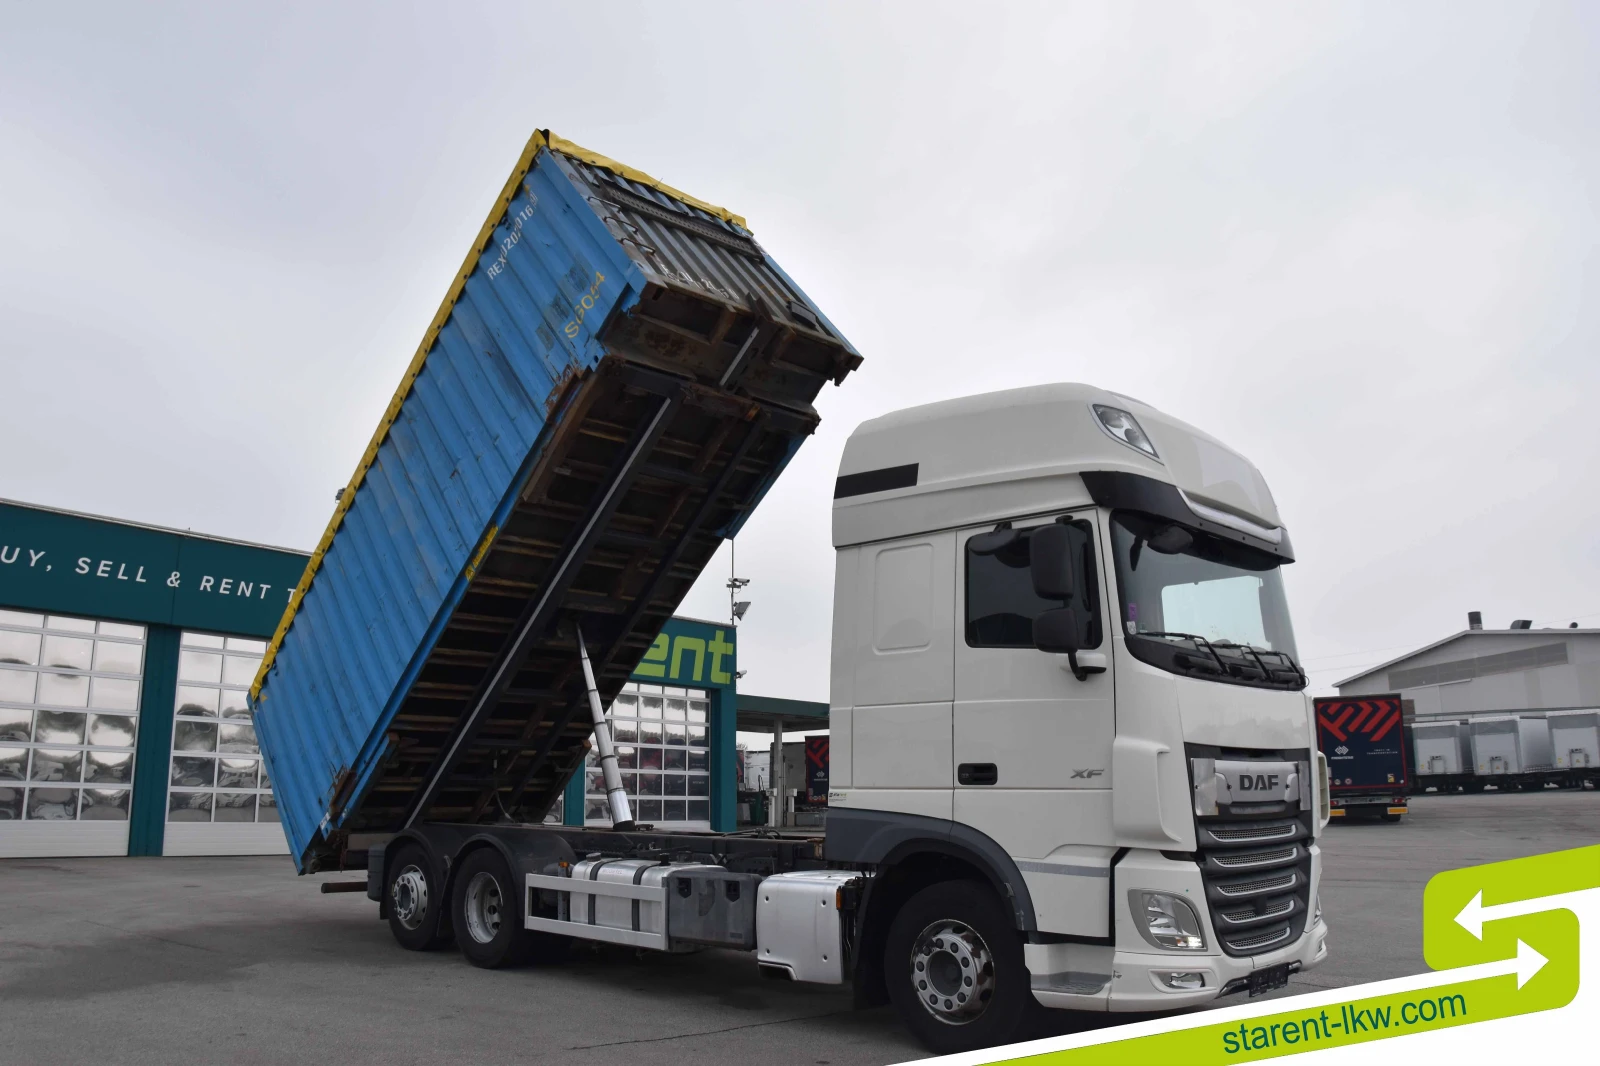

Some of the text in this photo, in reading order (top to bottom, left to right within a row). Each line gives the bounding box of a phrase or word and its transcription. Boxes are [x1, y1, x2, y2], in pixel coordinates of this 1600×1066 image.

[75, 557, 147, 583] SELL
[166, 571, 181, 588] &
[200, 575, 271, 599] RENT
[1070, 768, 1105, 779] XF
[1239, 774, 1279, 791] DAF
